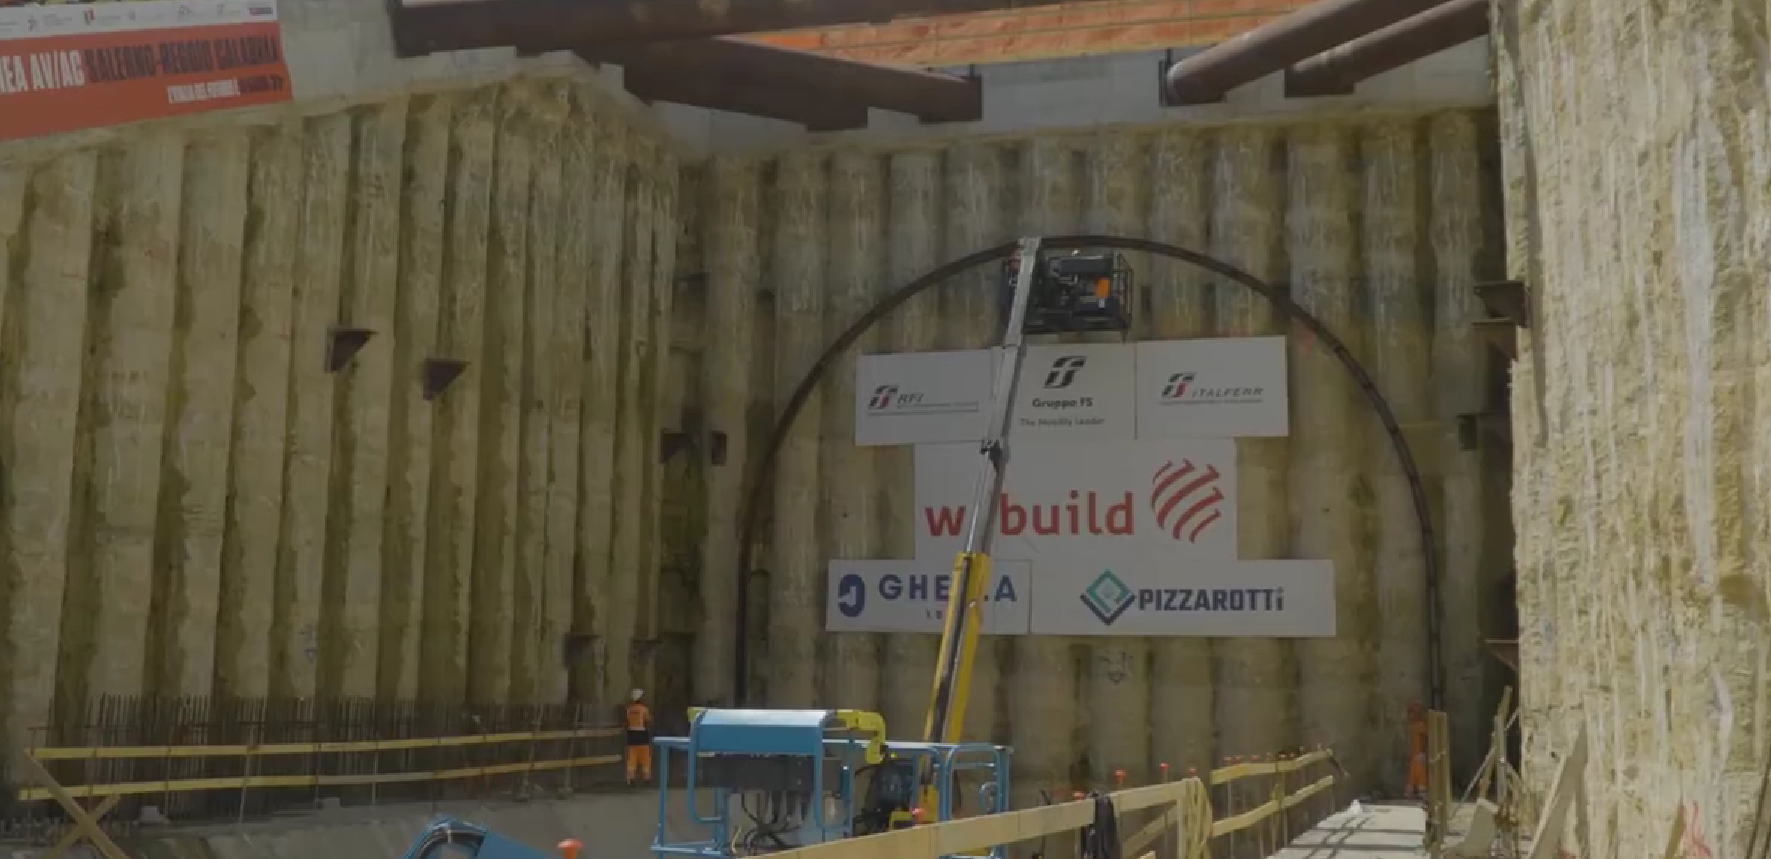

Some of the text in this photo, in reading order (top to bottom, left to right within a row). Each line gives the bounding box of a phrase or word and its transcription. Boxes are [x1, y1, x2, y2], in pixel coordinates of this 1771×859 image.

[30, 49, 85, 91] AV/AC
[1032, 396, 1102, 409] Gruppo FS
[1020, 417, 1105, 428] The Mobility Leader
[925, 490, 1134, 538] wbuild
[878, 574, 1017, 602] GHEA
